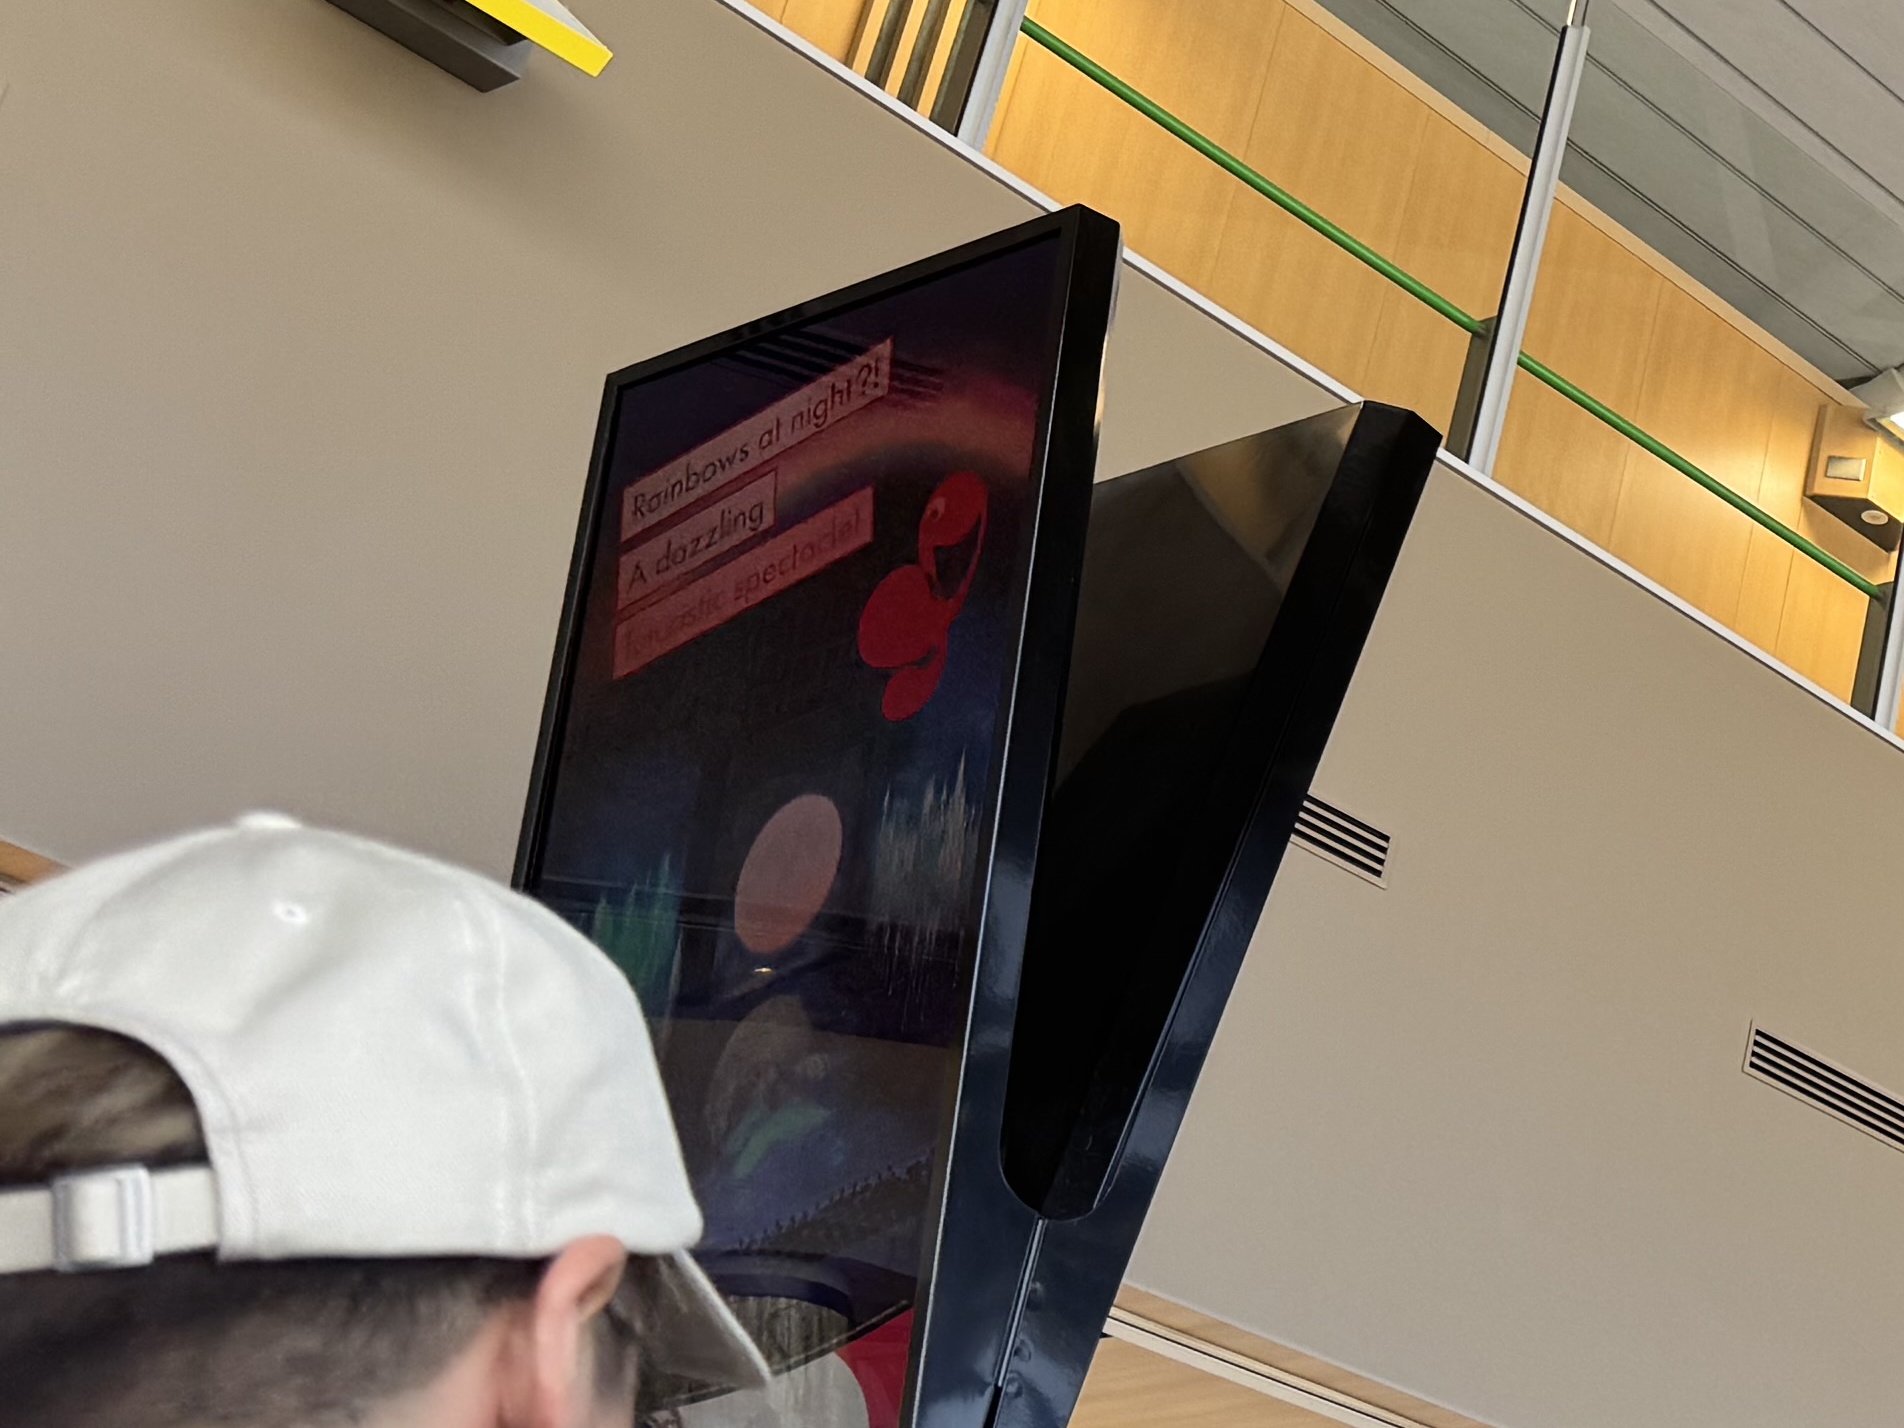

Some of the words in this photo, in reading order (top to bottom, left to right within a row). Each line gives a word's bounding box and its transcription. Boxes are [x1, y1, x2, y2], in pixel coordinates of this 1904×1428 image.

[631, 440, 751, 520] Rainbows
[758, 417, 781, 449] at
[790, 379, 852, 438] night
[627, 562, 648, 594] A
[654, 499, 764, 577] dazzling
